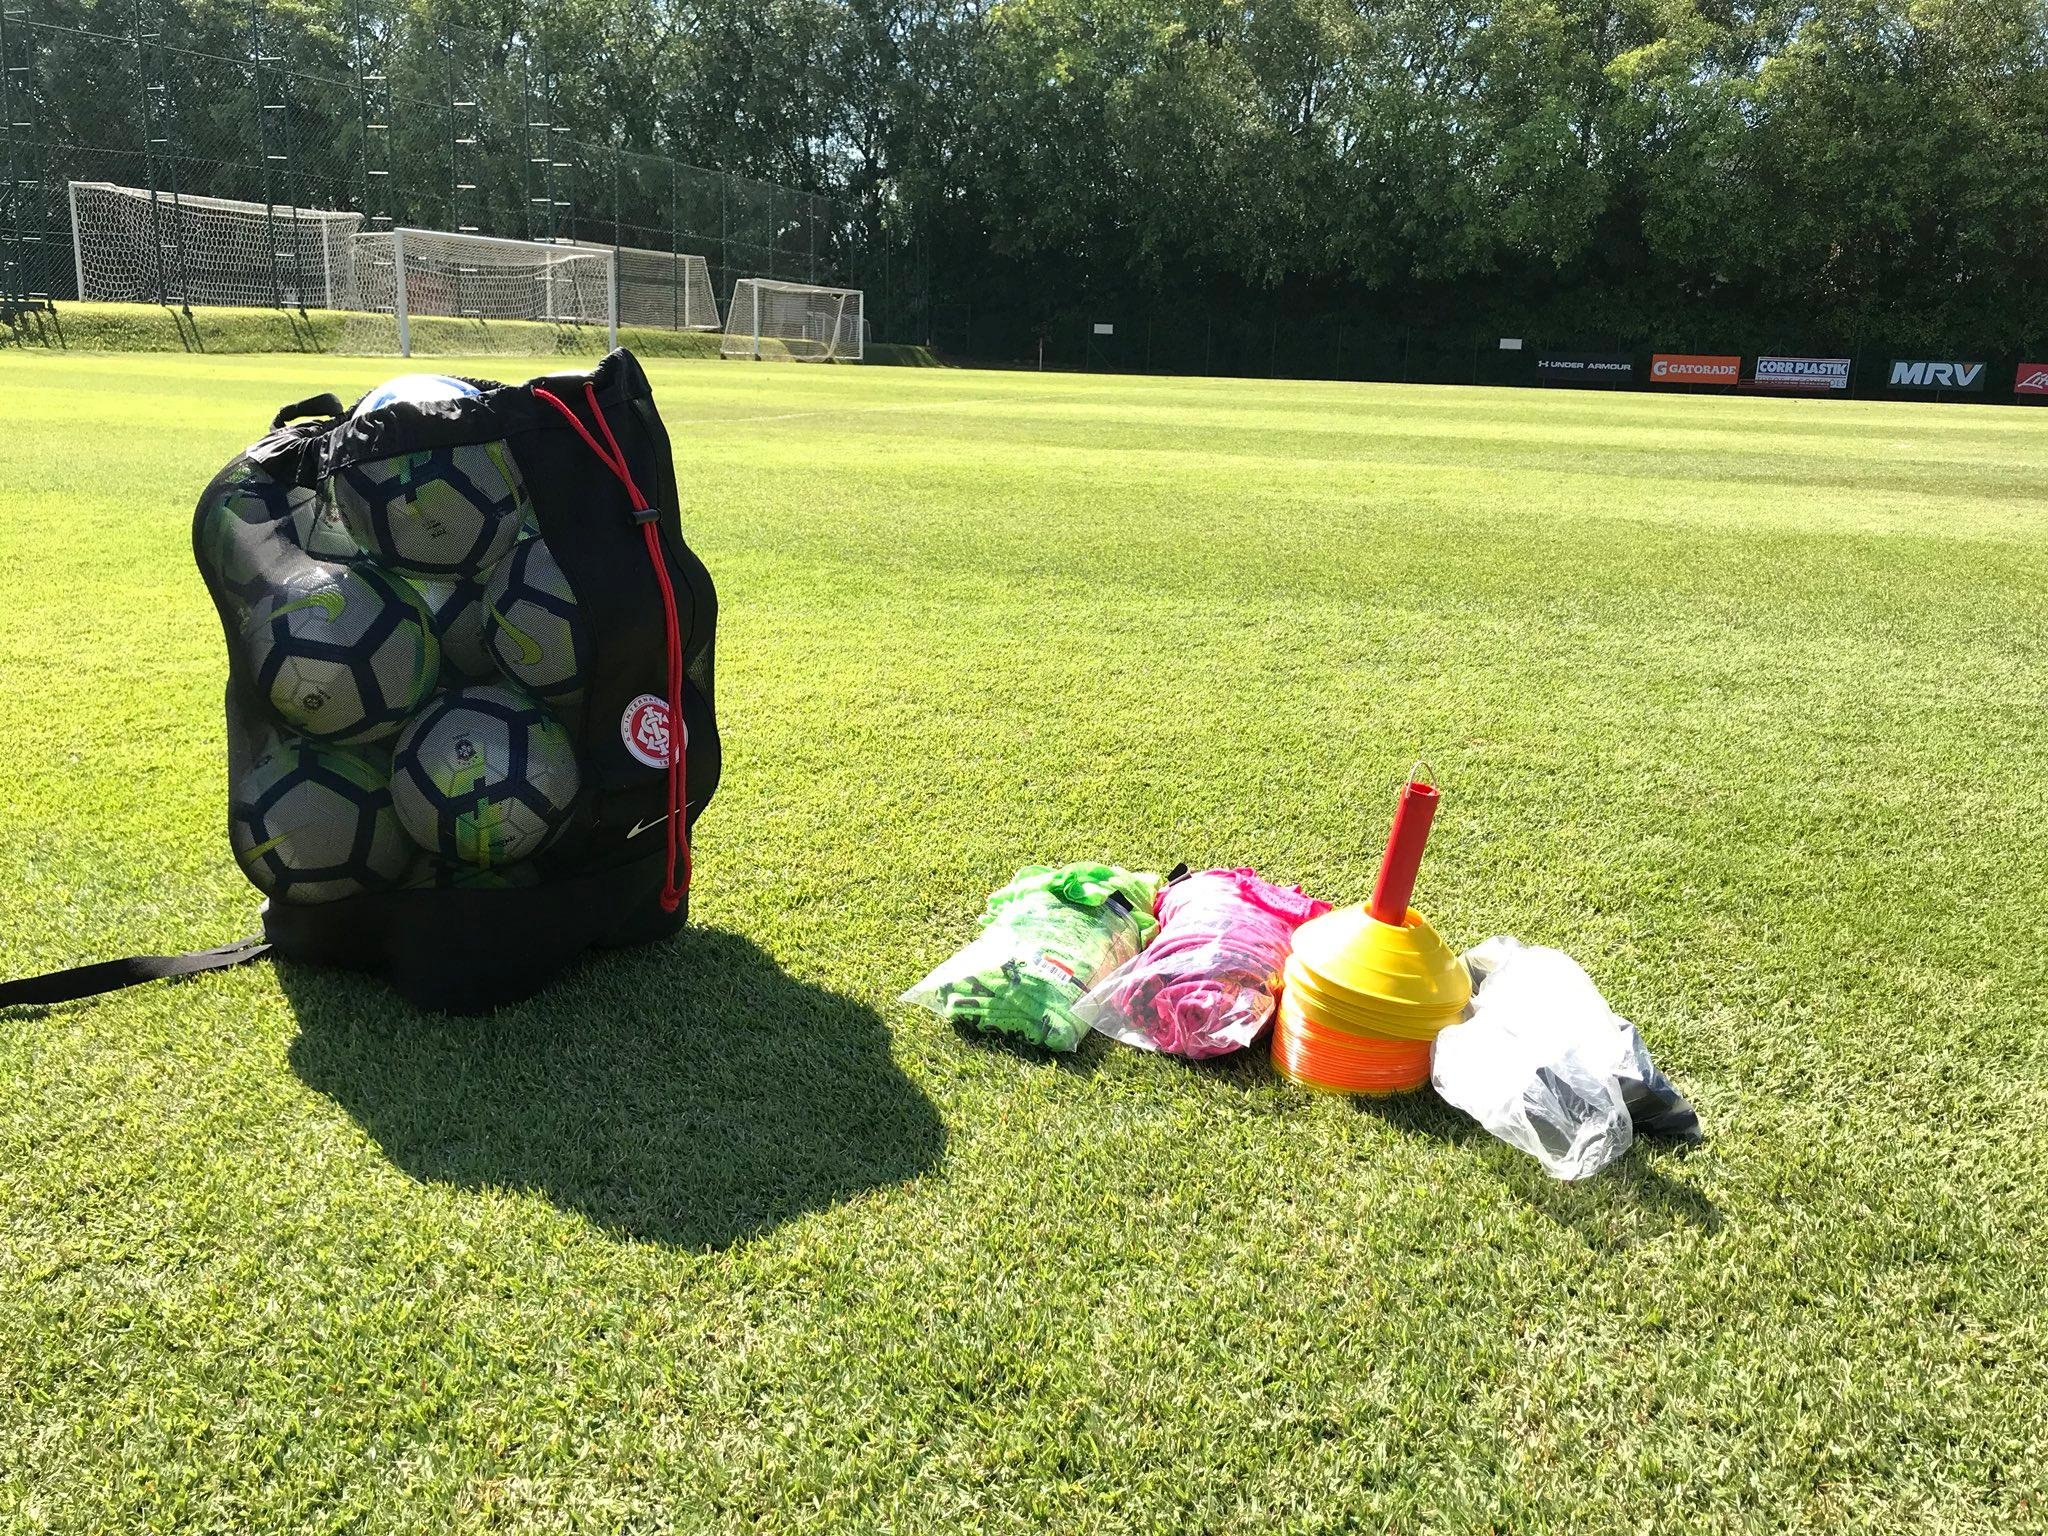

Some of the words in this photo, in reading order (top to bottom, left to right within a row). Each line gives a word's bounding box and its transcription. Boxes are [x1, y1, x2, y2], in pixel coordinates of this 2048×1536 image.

[1550, 361, 1584, 369] UNDER
[1587, 362, 1632, 371] ARMOUR
[1669, 364, 1737, 376] GATORADE
[1795, 362, 1847, 375] PLASTIK
[1890, 362, 1983, 386] MRV
